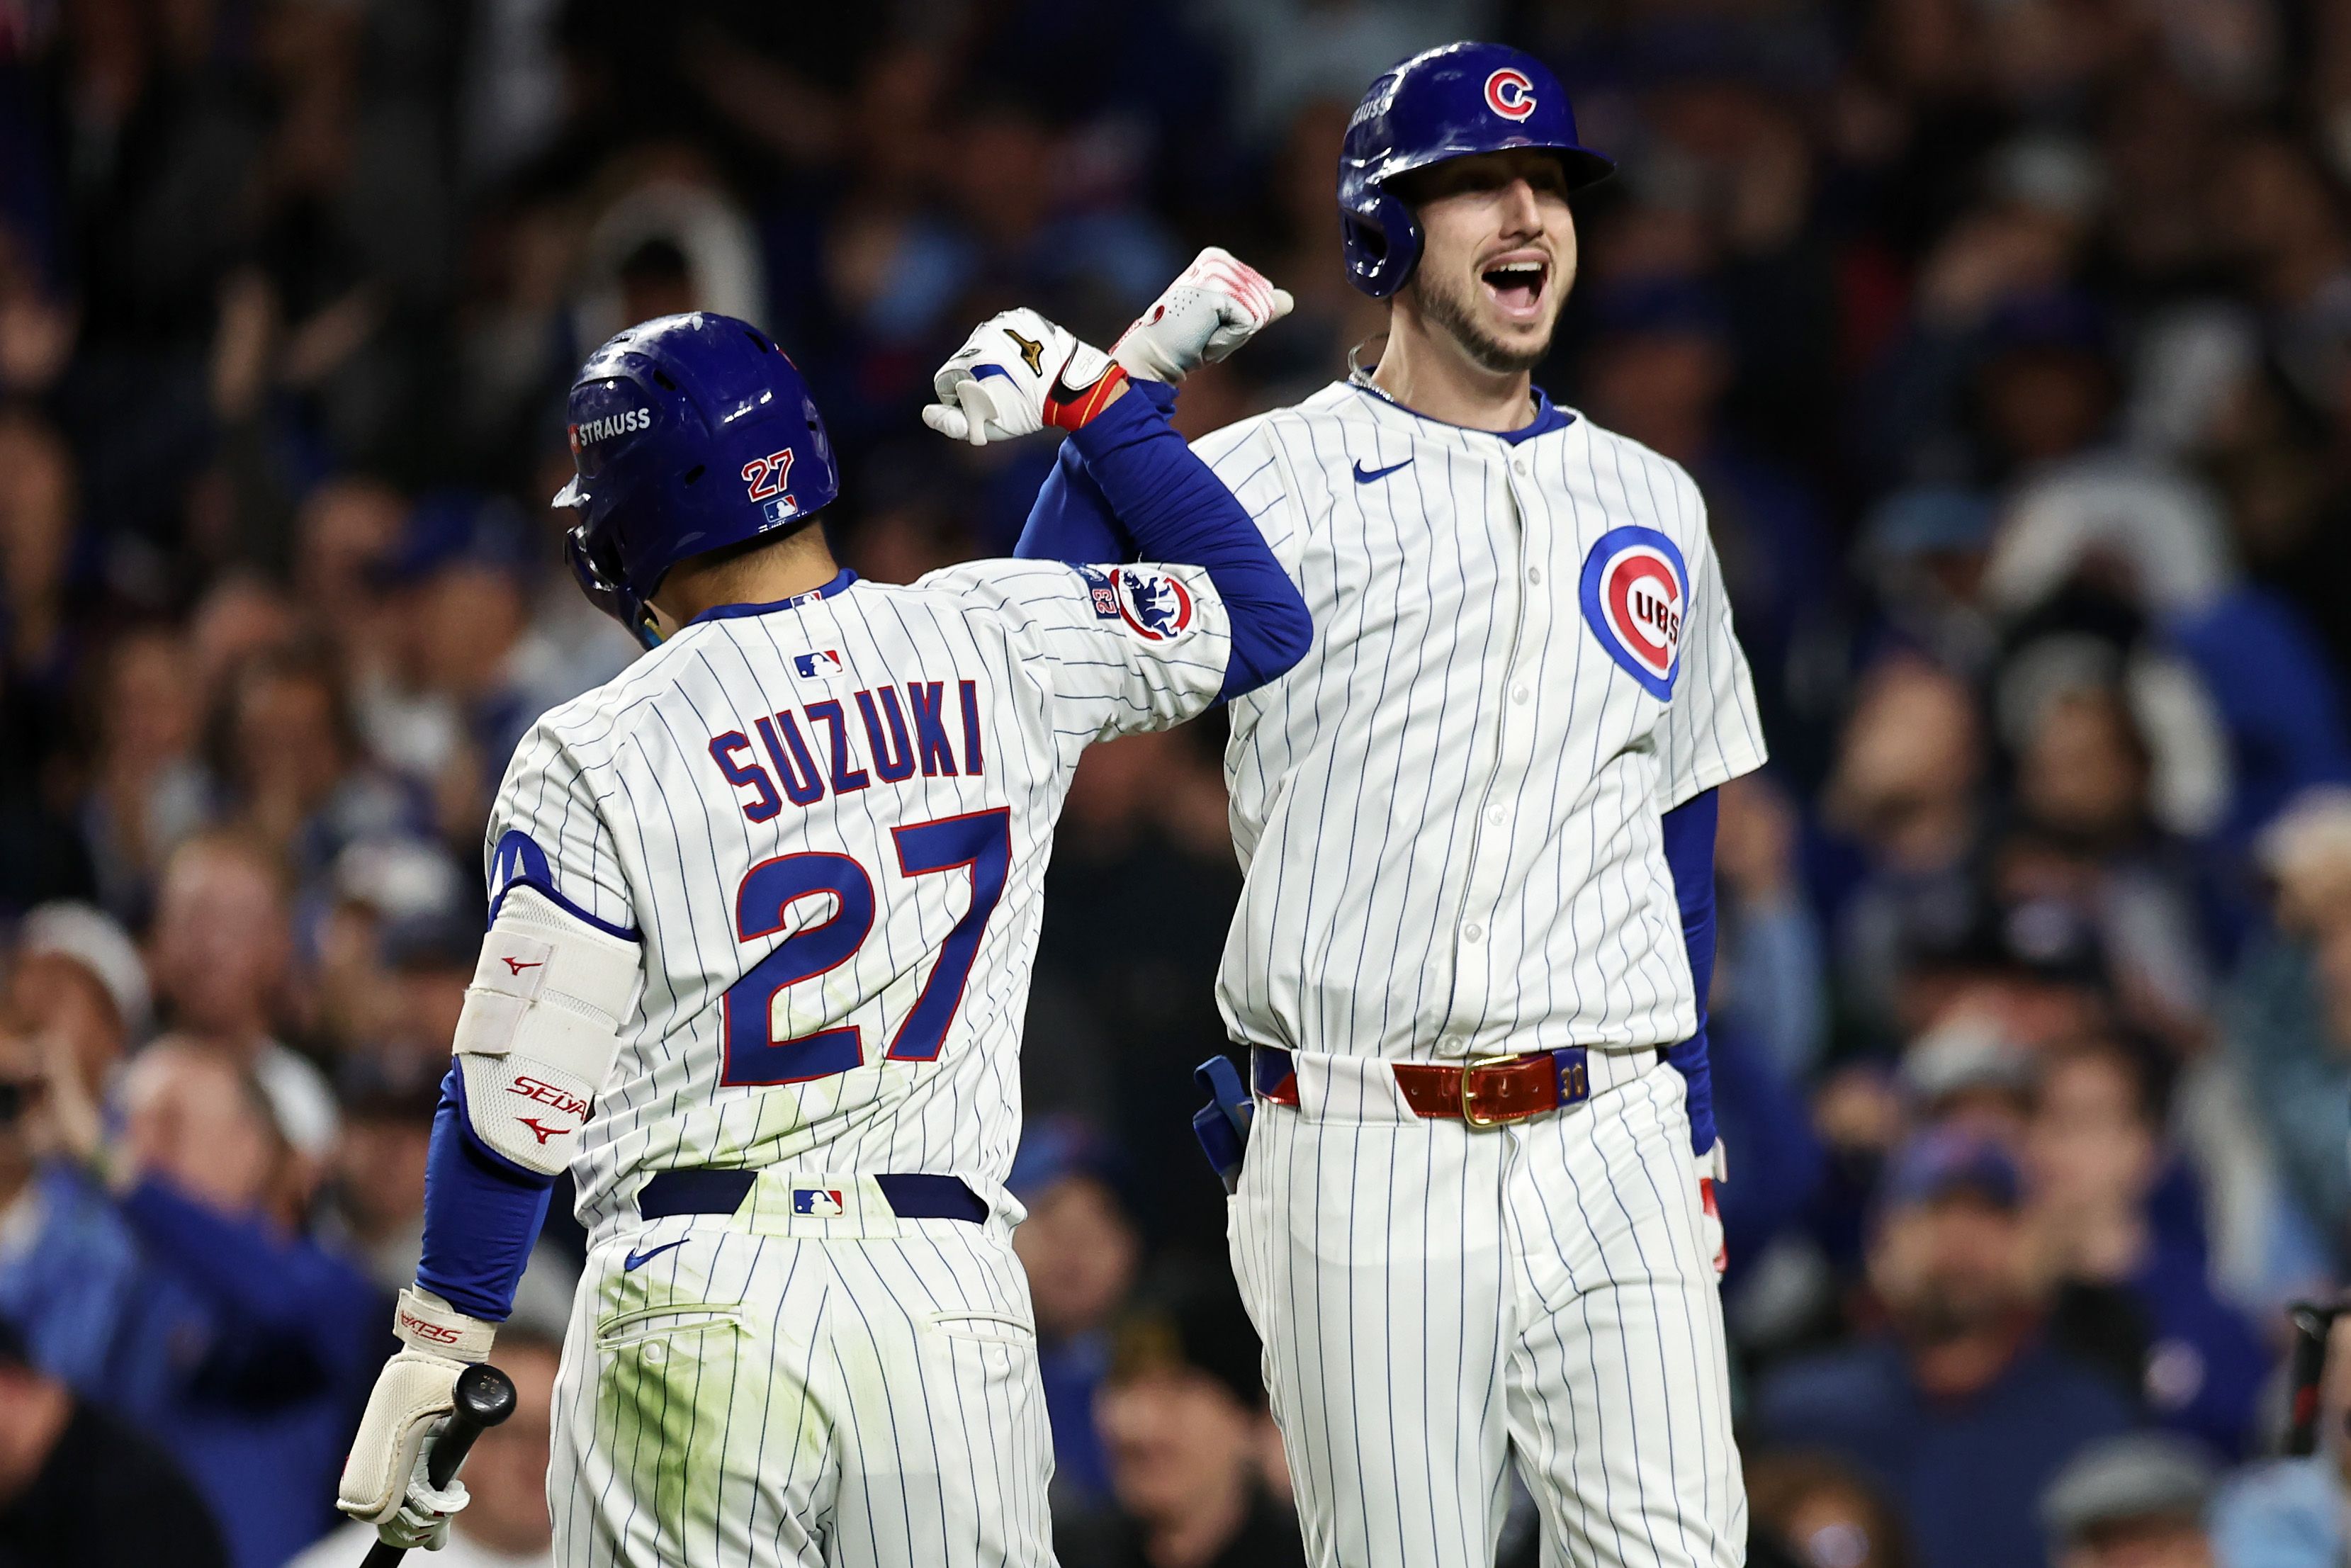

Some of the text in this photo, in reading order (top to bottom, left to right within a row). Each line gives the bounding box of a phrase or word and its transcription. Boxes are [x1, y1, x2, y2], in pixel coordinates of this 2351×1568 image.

[1484, 67, 1537, 120] C
[579, 407, 650, 446] STRAUSS
[741, 447, 794, 502] 27
[1093, 588, 1117, 614] 23
[709, 679, 983, 823] SUZUKI
[720, 806, 1013, 1087] 27
